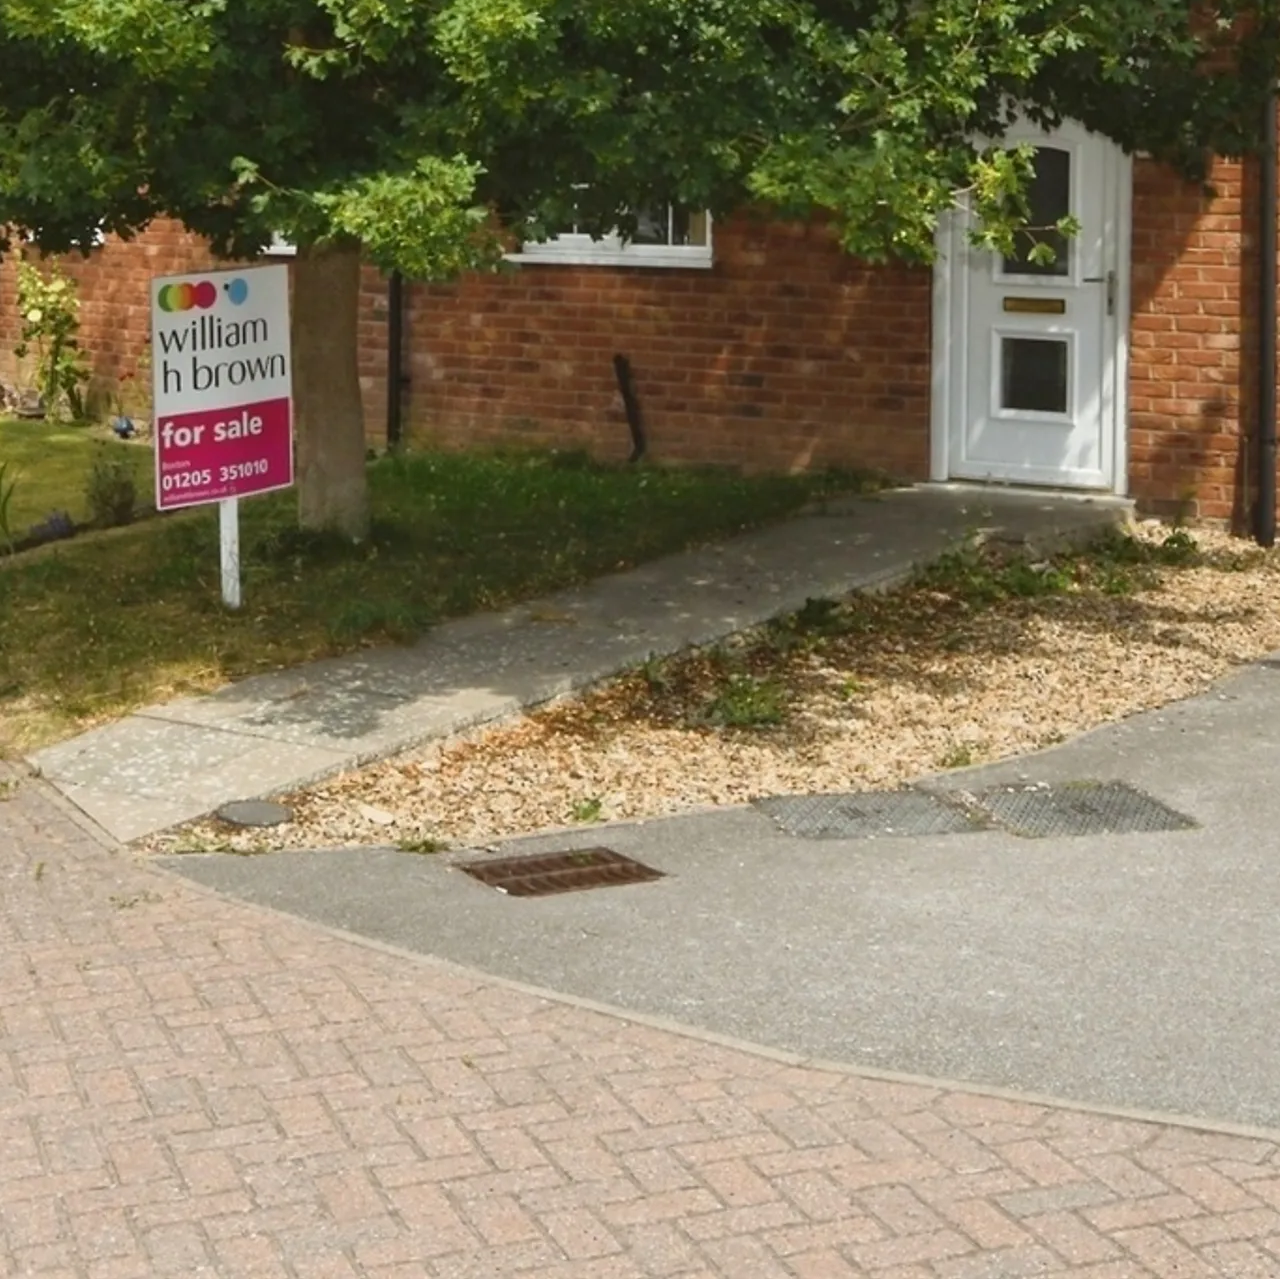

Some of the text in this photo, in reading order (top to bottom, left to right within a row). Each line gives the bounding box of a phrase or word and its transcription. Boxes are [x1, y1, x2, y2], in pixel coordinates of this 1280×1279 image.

[158, 315, 268, 354] william
[163, 353, 285, 394] h brown
[161, 411, 262, 450] for sale
[162, 458, 268, 491] 01205 351010
